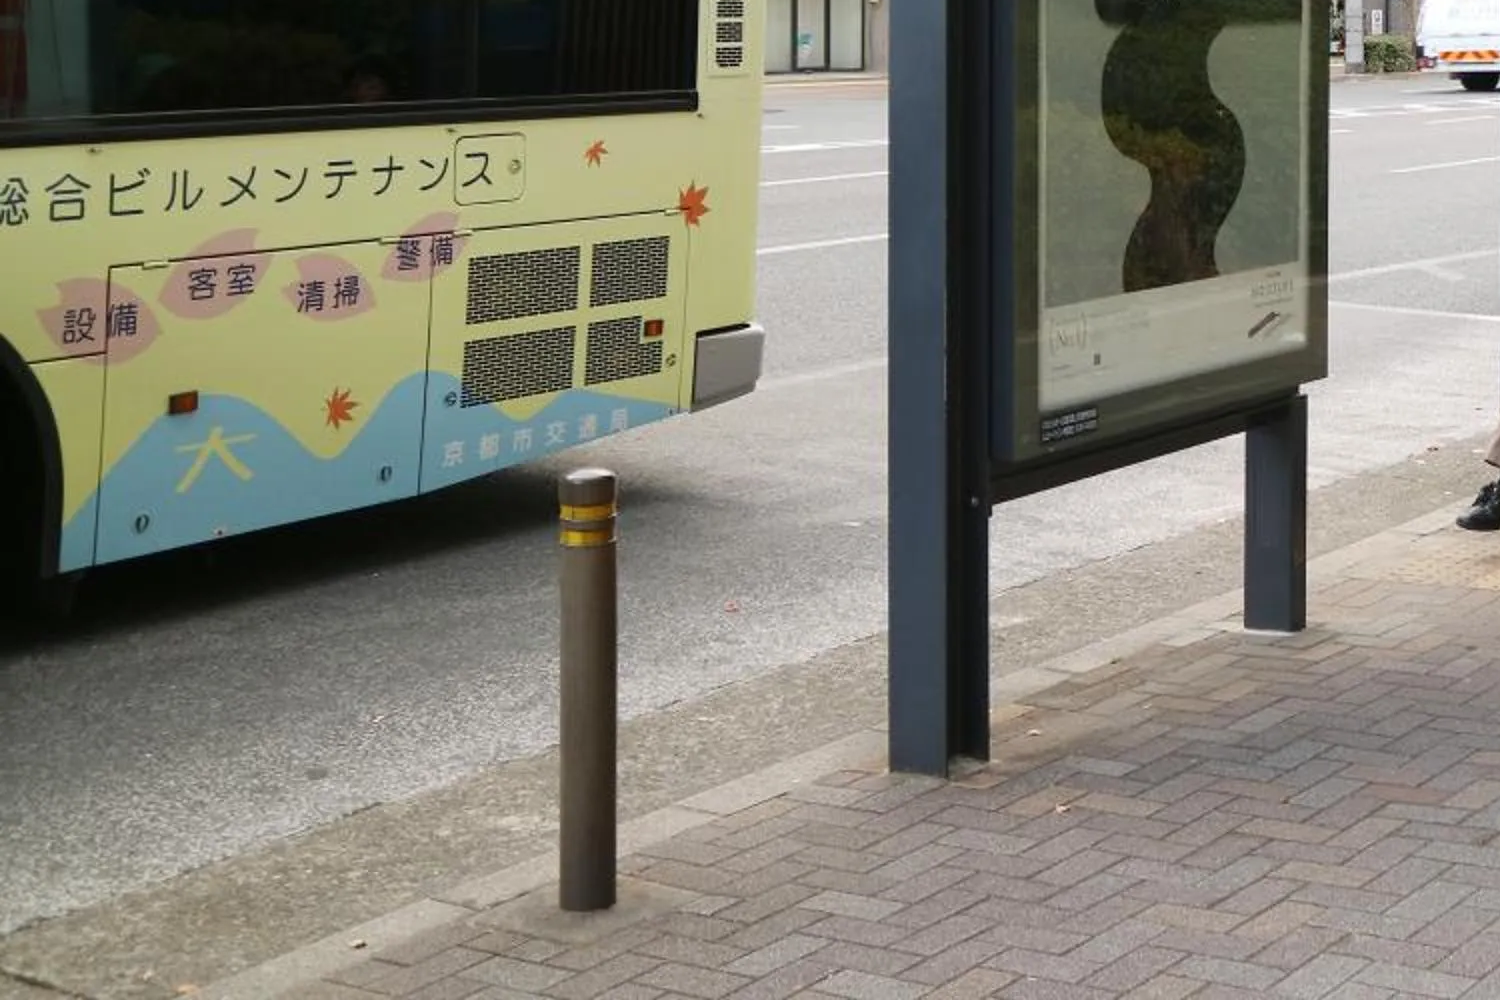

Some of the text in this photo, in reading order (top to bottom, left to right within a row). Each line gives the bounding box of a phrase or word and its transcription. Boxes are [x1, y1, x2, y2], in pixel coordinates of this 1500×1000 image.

[0, 150, 494, 227] 総合ビルメンテナンス
[188, 264, 257, 301] 客室
[297, 275, 360, 313] 清掃
[62, 302, 138, 345] 設備
[441, 407, 629, 469] 京都市交通局
